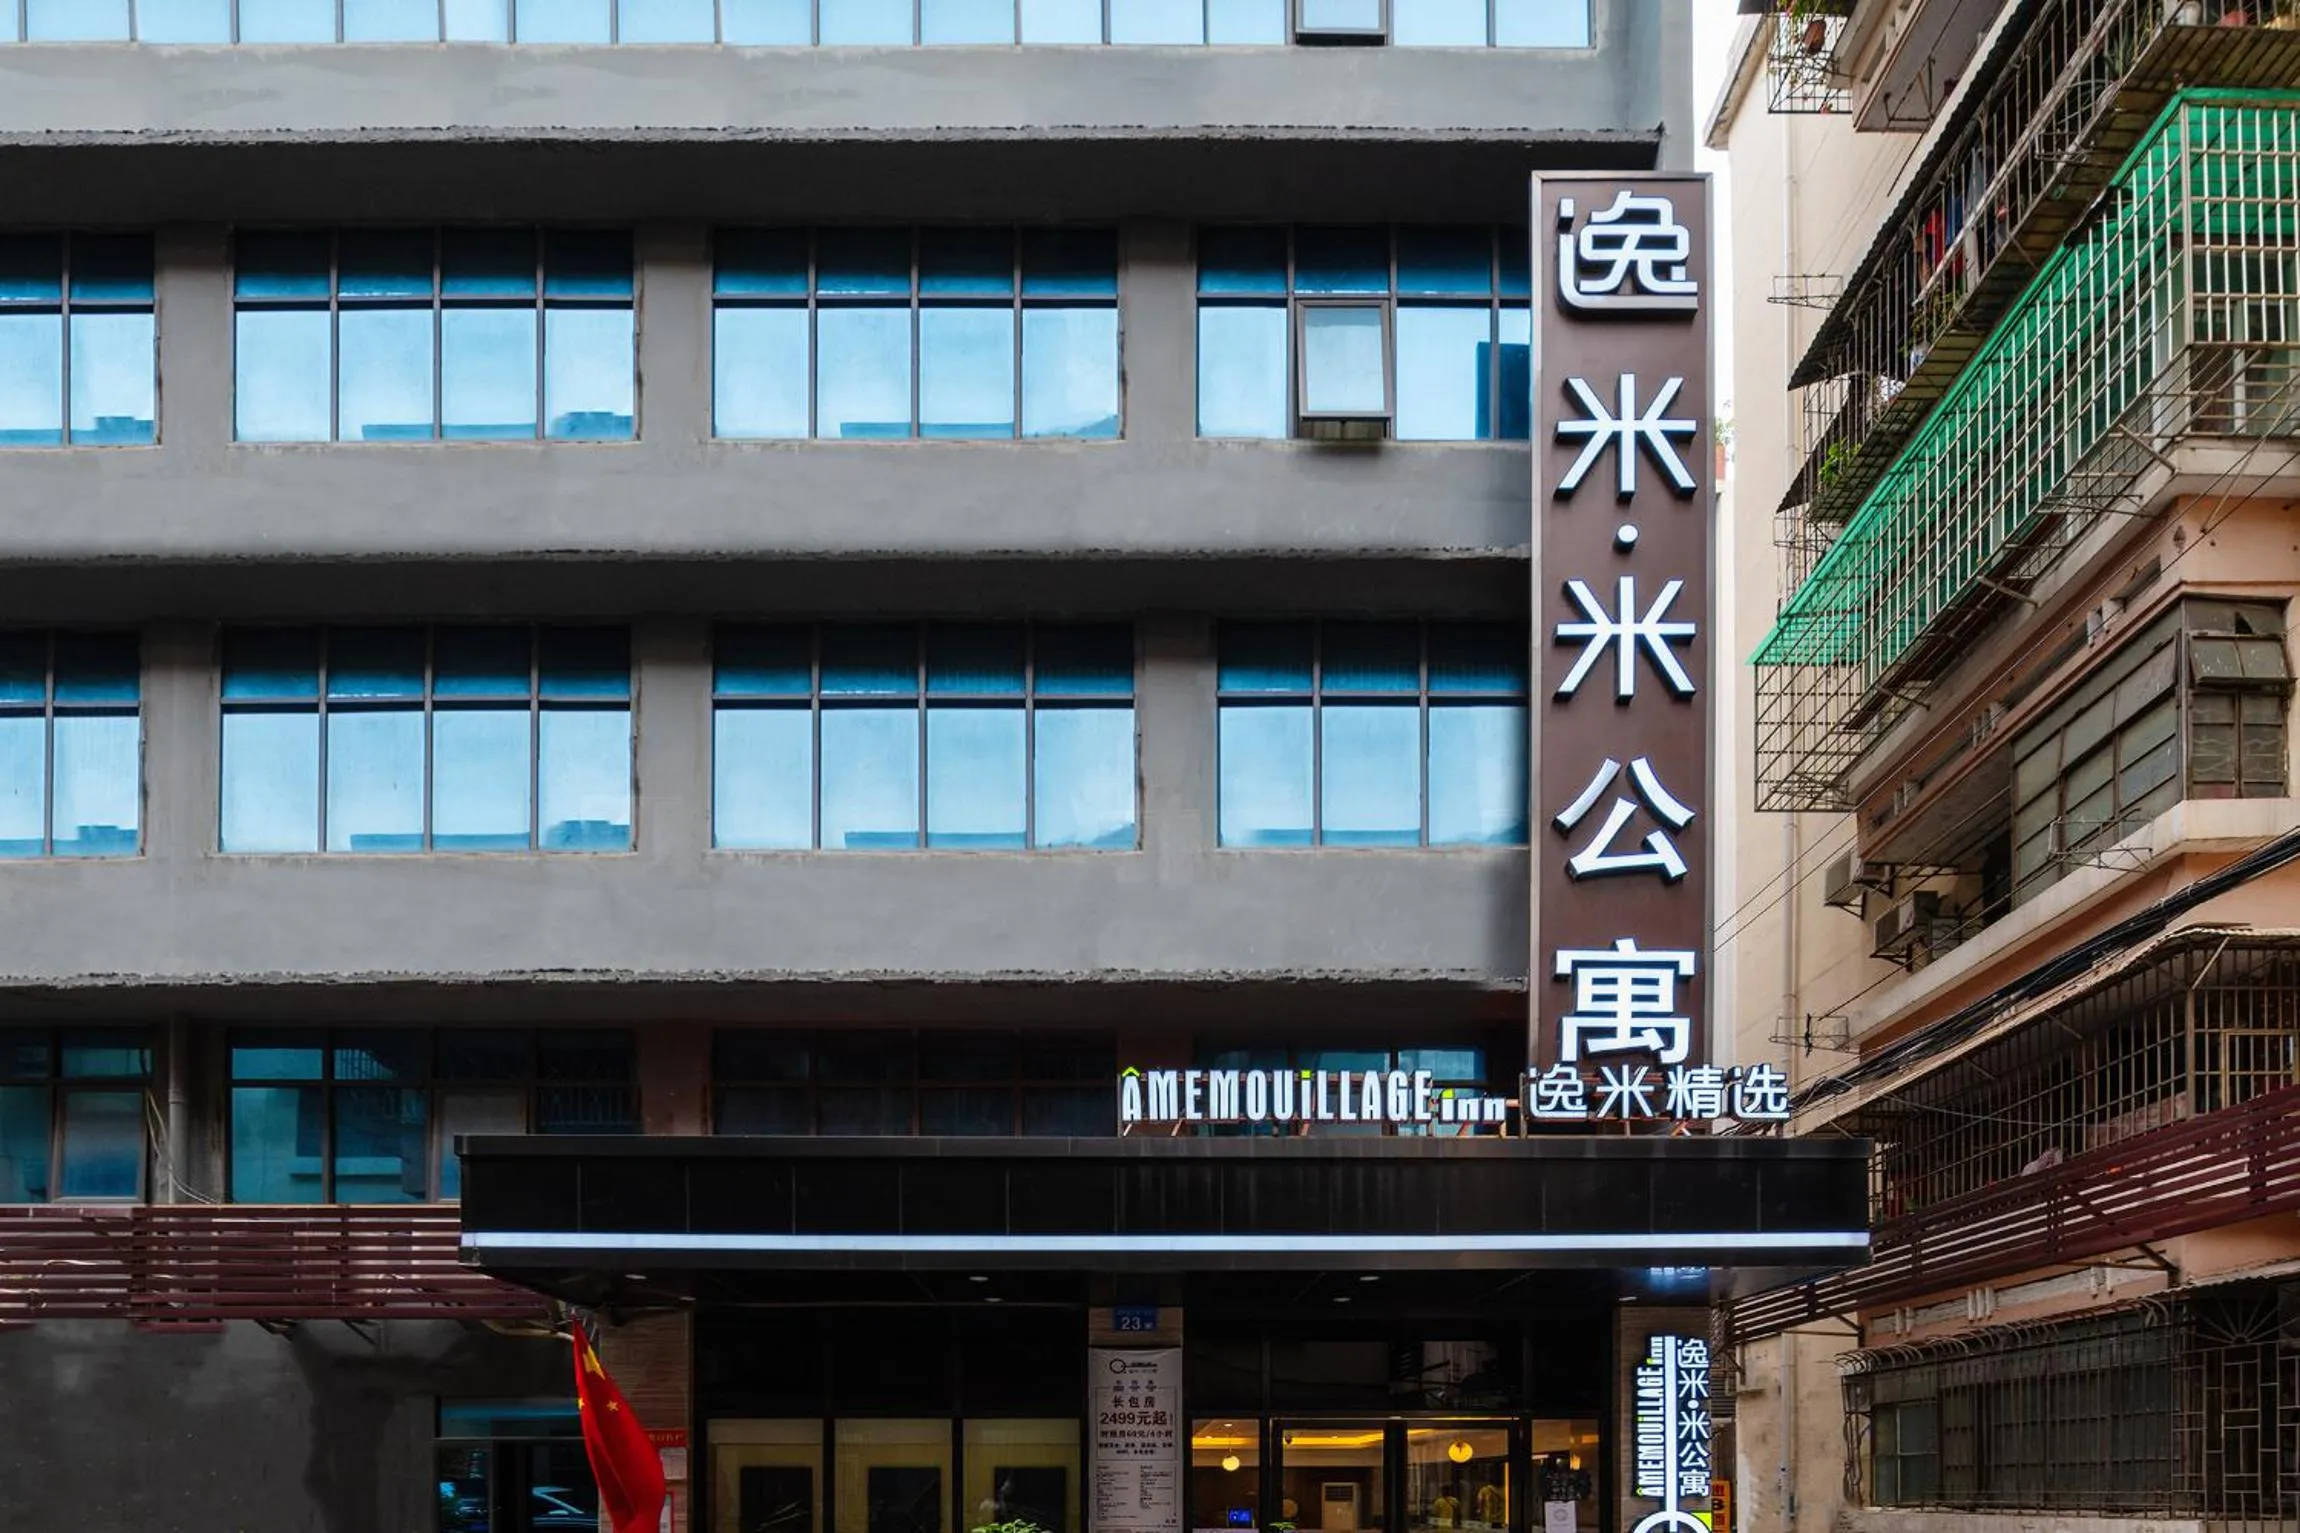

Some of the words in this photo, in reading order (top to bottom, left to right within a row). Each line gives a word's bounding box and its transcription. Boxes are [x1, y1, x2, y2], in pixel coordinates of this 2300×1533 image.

[1440, 1088, 1506, 1121] inn
[1529, 1063, 1790, 1119] 逸米精选
